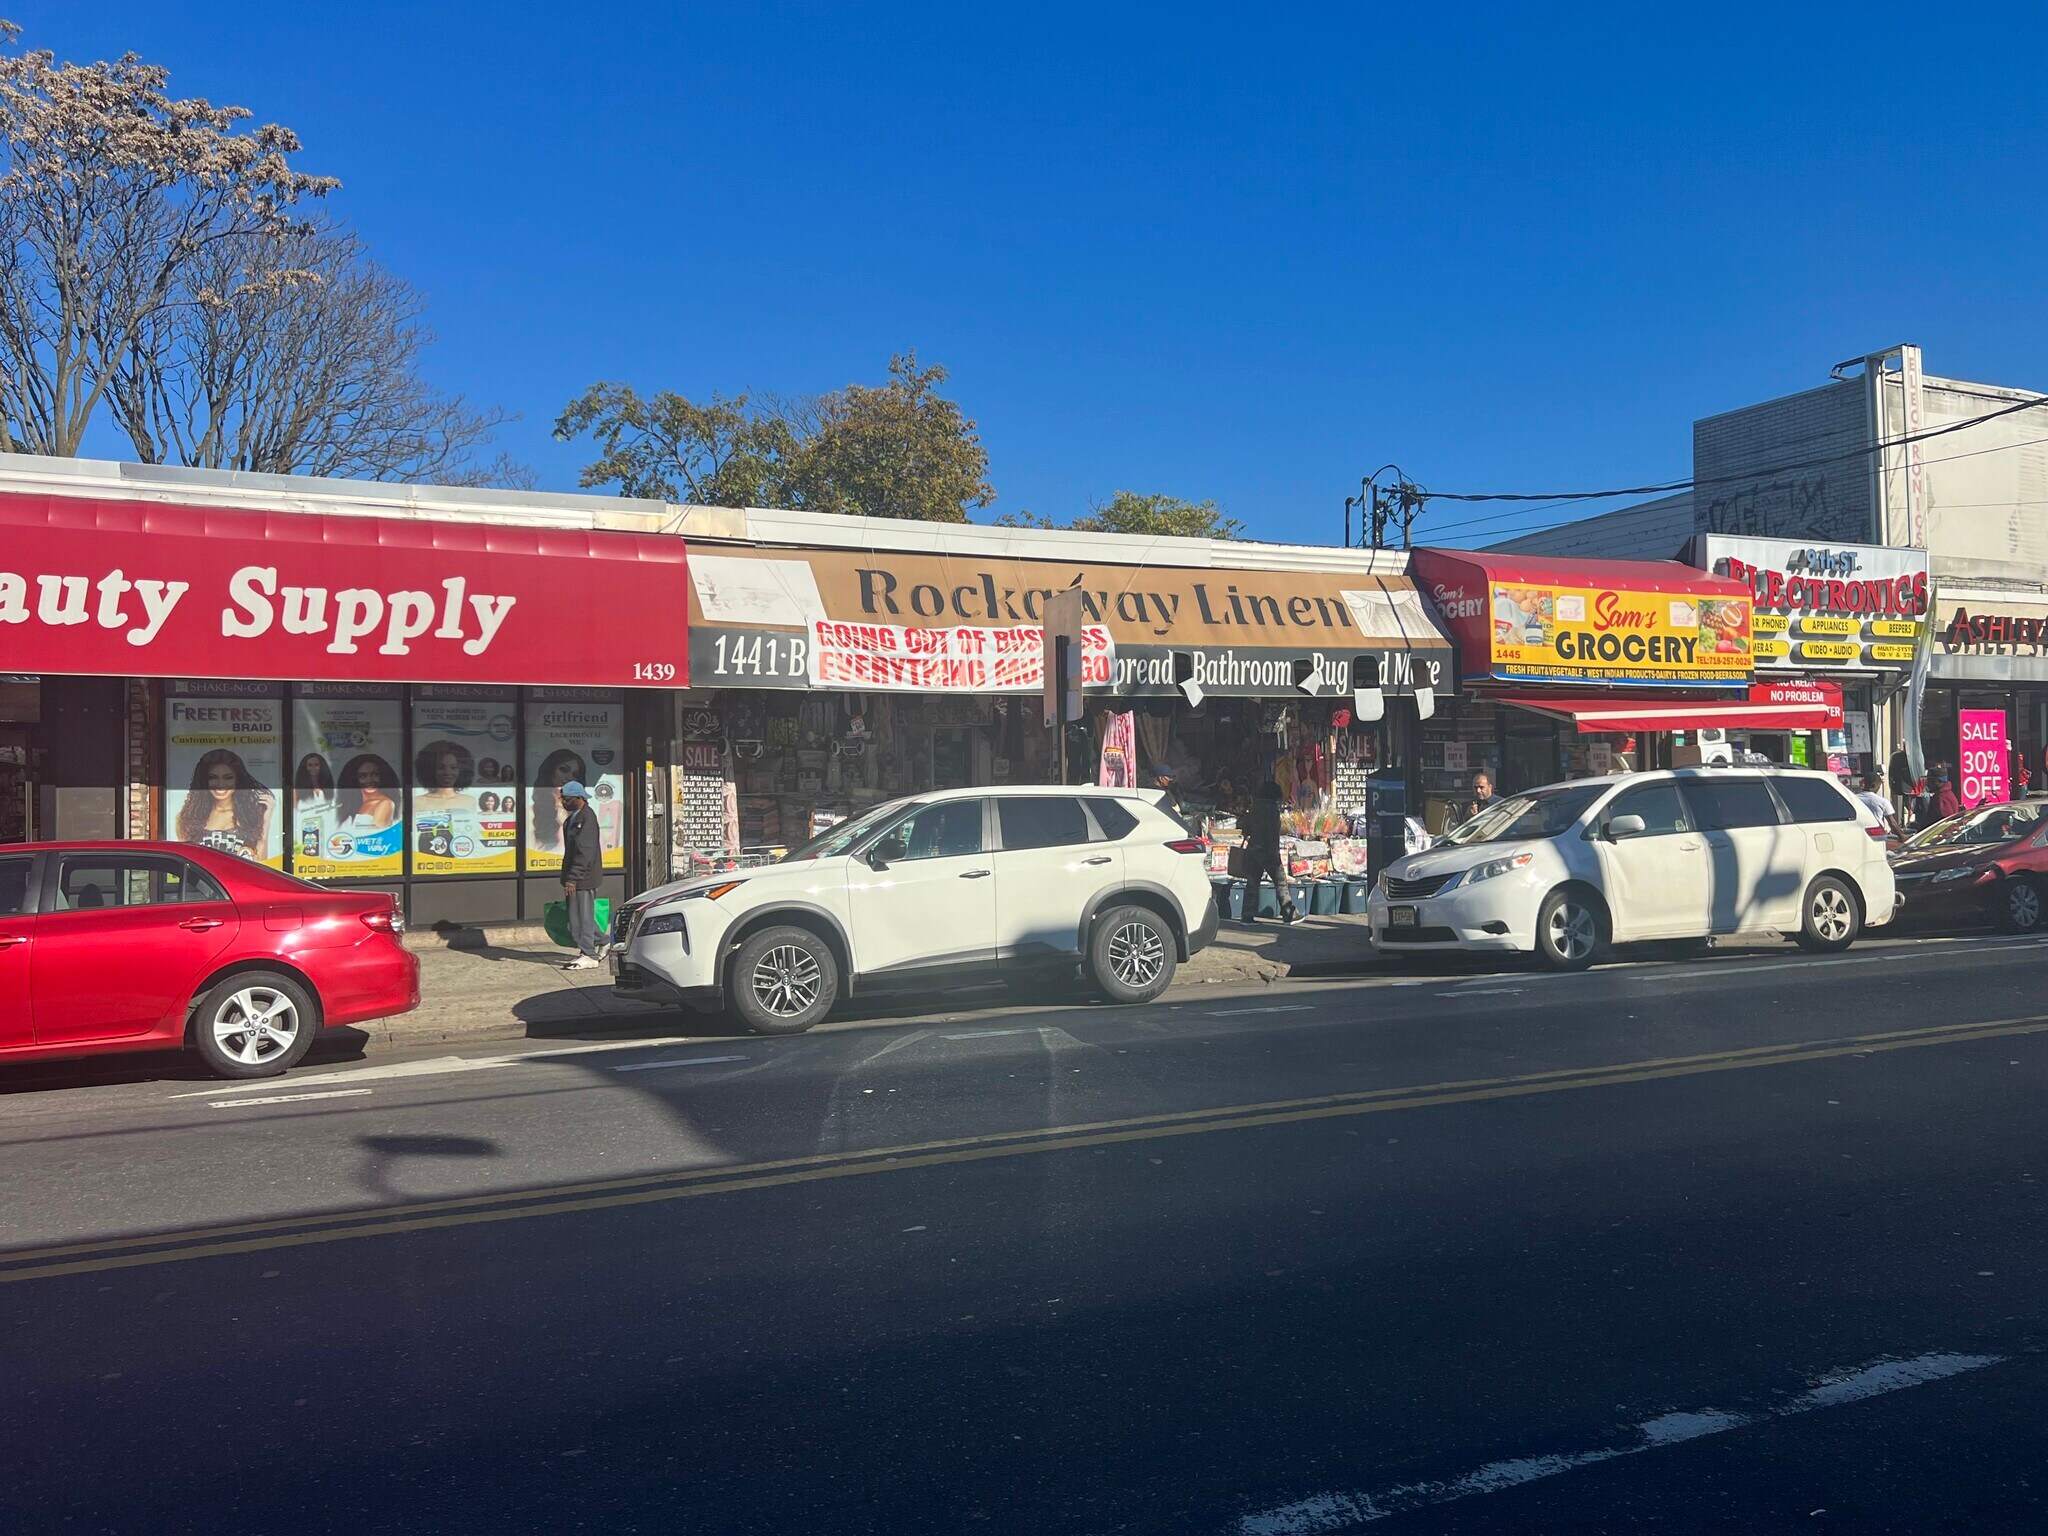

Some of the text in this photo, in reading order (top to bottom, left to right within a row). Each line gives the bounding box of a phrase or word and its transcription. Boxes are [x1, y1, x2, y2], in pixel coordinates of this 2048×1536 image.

[221, 566, 516, 656] Supply
[1192, 583, 1352, 627] Linen
[1593, 591, 1657, 631] Sam's
[1762, 618, 1786, 629] PHONES
[1812, 620, 1848, 631] APPLIANCES
[1889, 624, 1912, 634] BEEPERS
[816, 621, 897, 652] GOING
[904, 627, 949, 654] OUT
[957, 628, 987, 655] OF
[1556, 631, 1698, 663] GROCERY
[1496, 649, 1521, 659] 1445
[1809, 645, 1852, 655] VIDEO AUDIO
[632, 663, 675, 682] 1439
[819, 651, 1110, 687] EVERYTHING MUS GO
[1193, 649, 1292, 686] Bathroom
[1312, 652, 1348, 695] Rug
[1505, 664, 1526, 675] FRESH
[1587, 669, 1604, 678] WEST
[1604, 669, 1624, 678] INDIAN
[1677, 670, 1698, 680] FROZEN
[1771, 691, 1824, 702] NO PROBLEM
[232, 723, 273, 732] BRAID
[543, 711, 608, 726] girlfriend
[240, 735, 276, 744] Choice!
[1962, 722, 1999, 741] SALE
[1339, 735, 1372, 757] SALE
[685, 746, 719, 767] SALE
[1963, 751, 2000, 774] 30%
[1963, 776, 2002, 800] OFF
[1372, 791, 1380, 807] P
